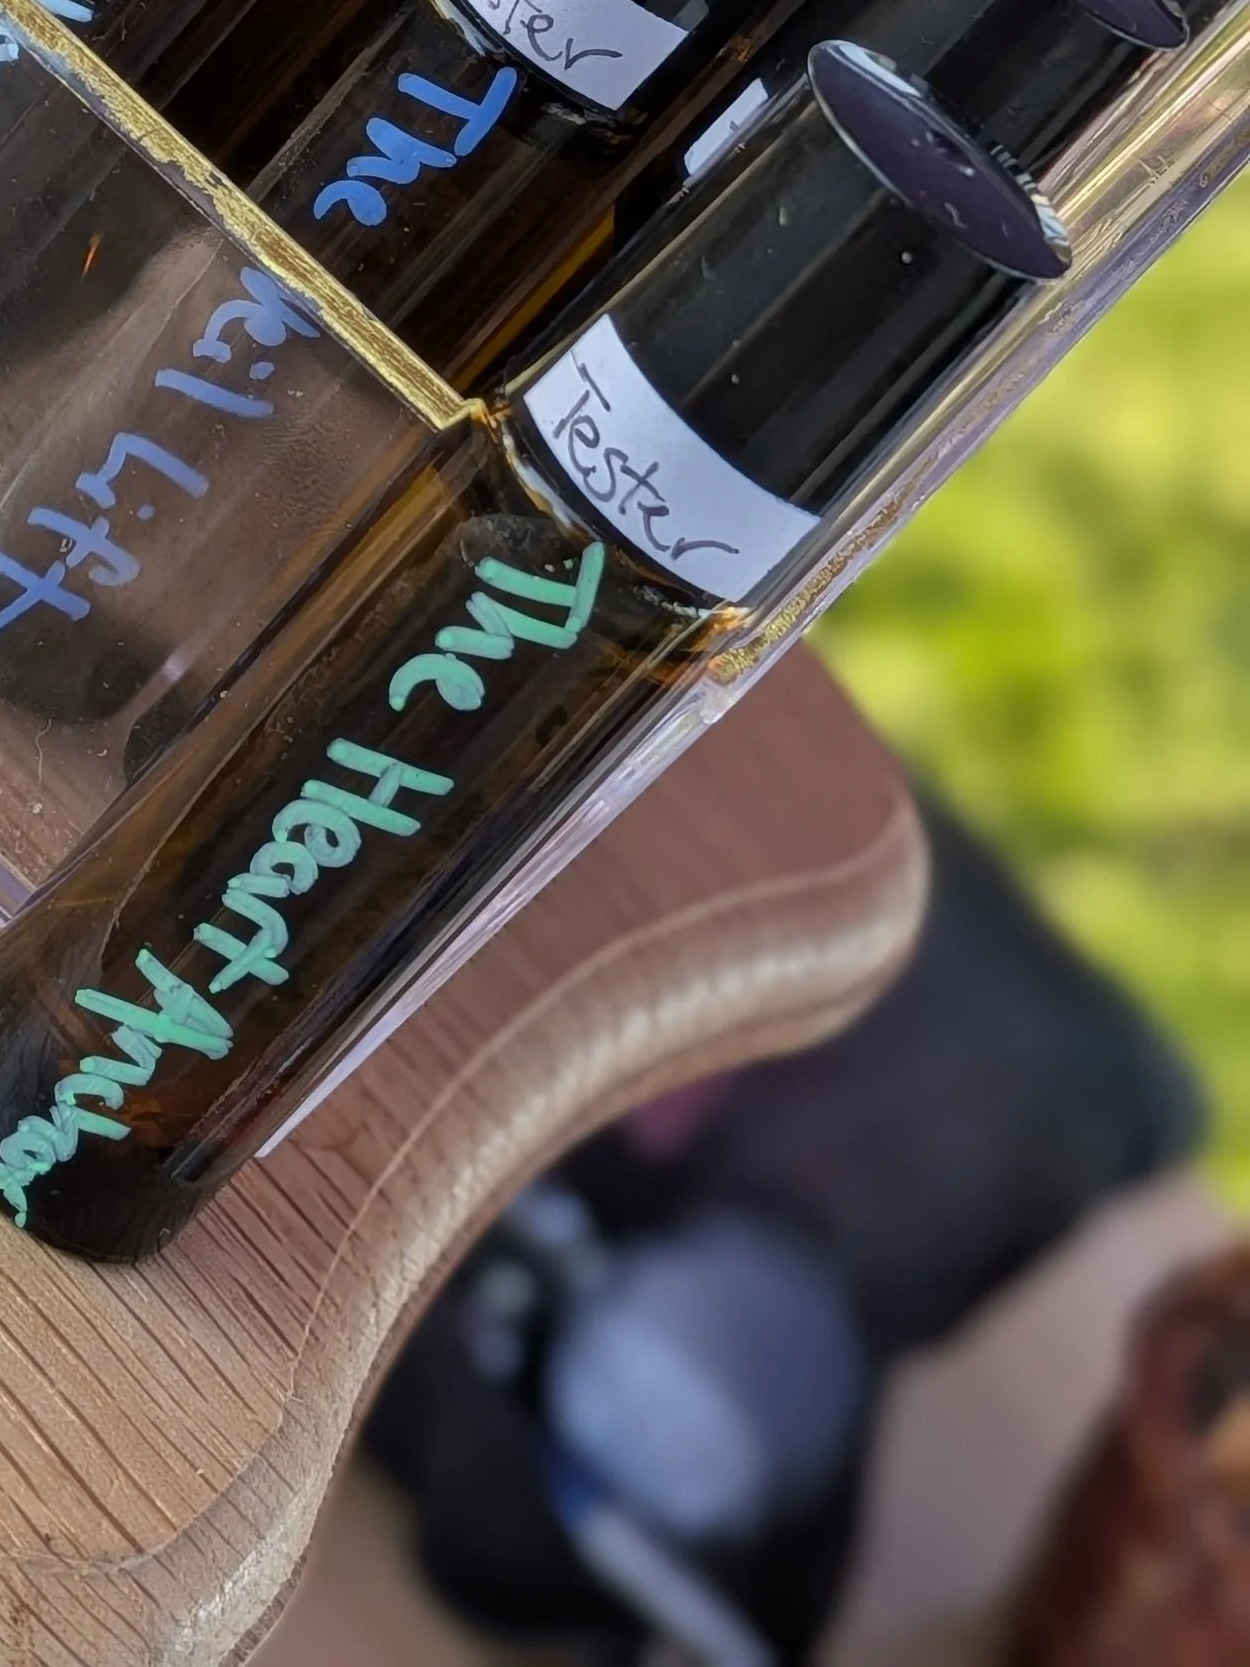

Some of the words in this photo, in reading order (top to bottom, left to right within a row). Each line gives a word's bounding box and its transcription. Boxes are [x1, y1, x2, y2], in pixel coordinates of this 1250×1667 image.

[313, 66, 517, 226] The
[551, 351, 739, 561] Tester
[389, 542, 605, 711] The
[194, 737, 454, 993] Heart
